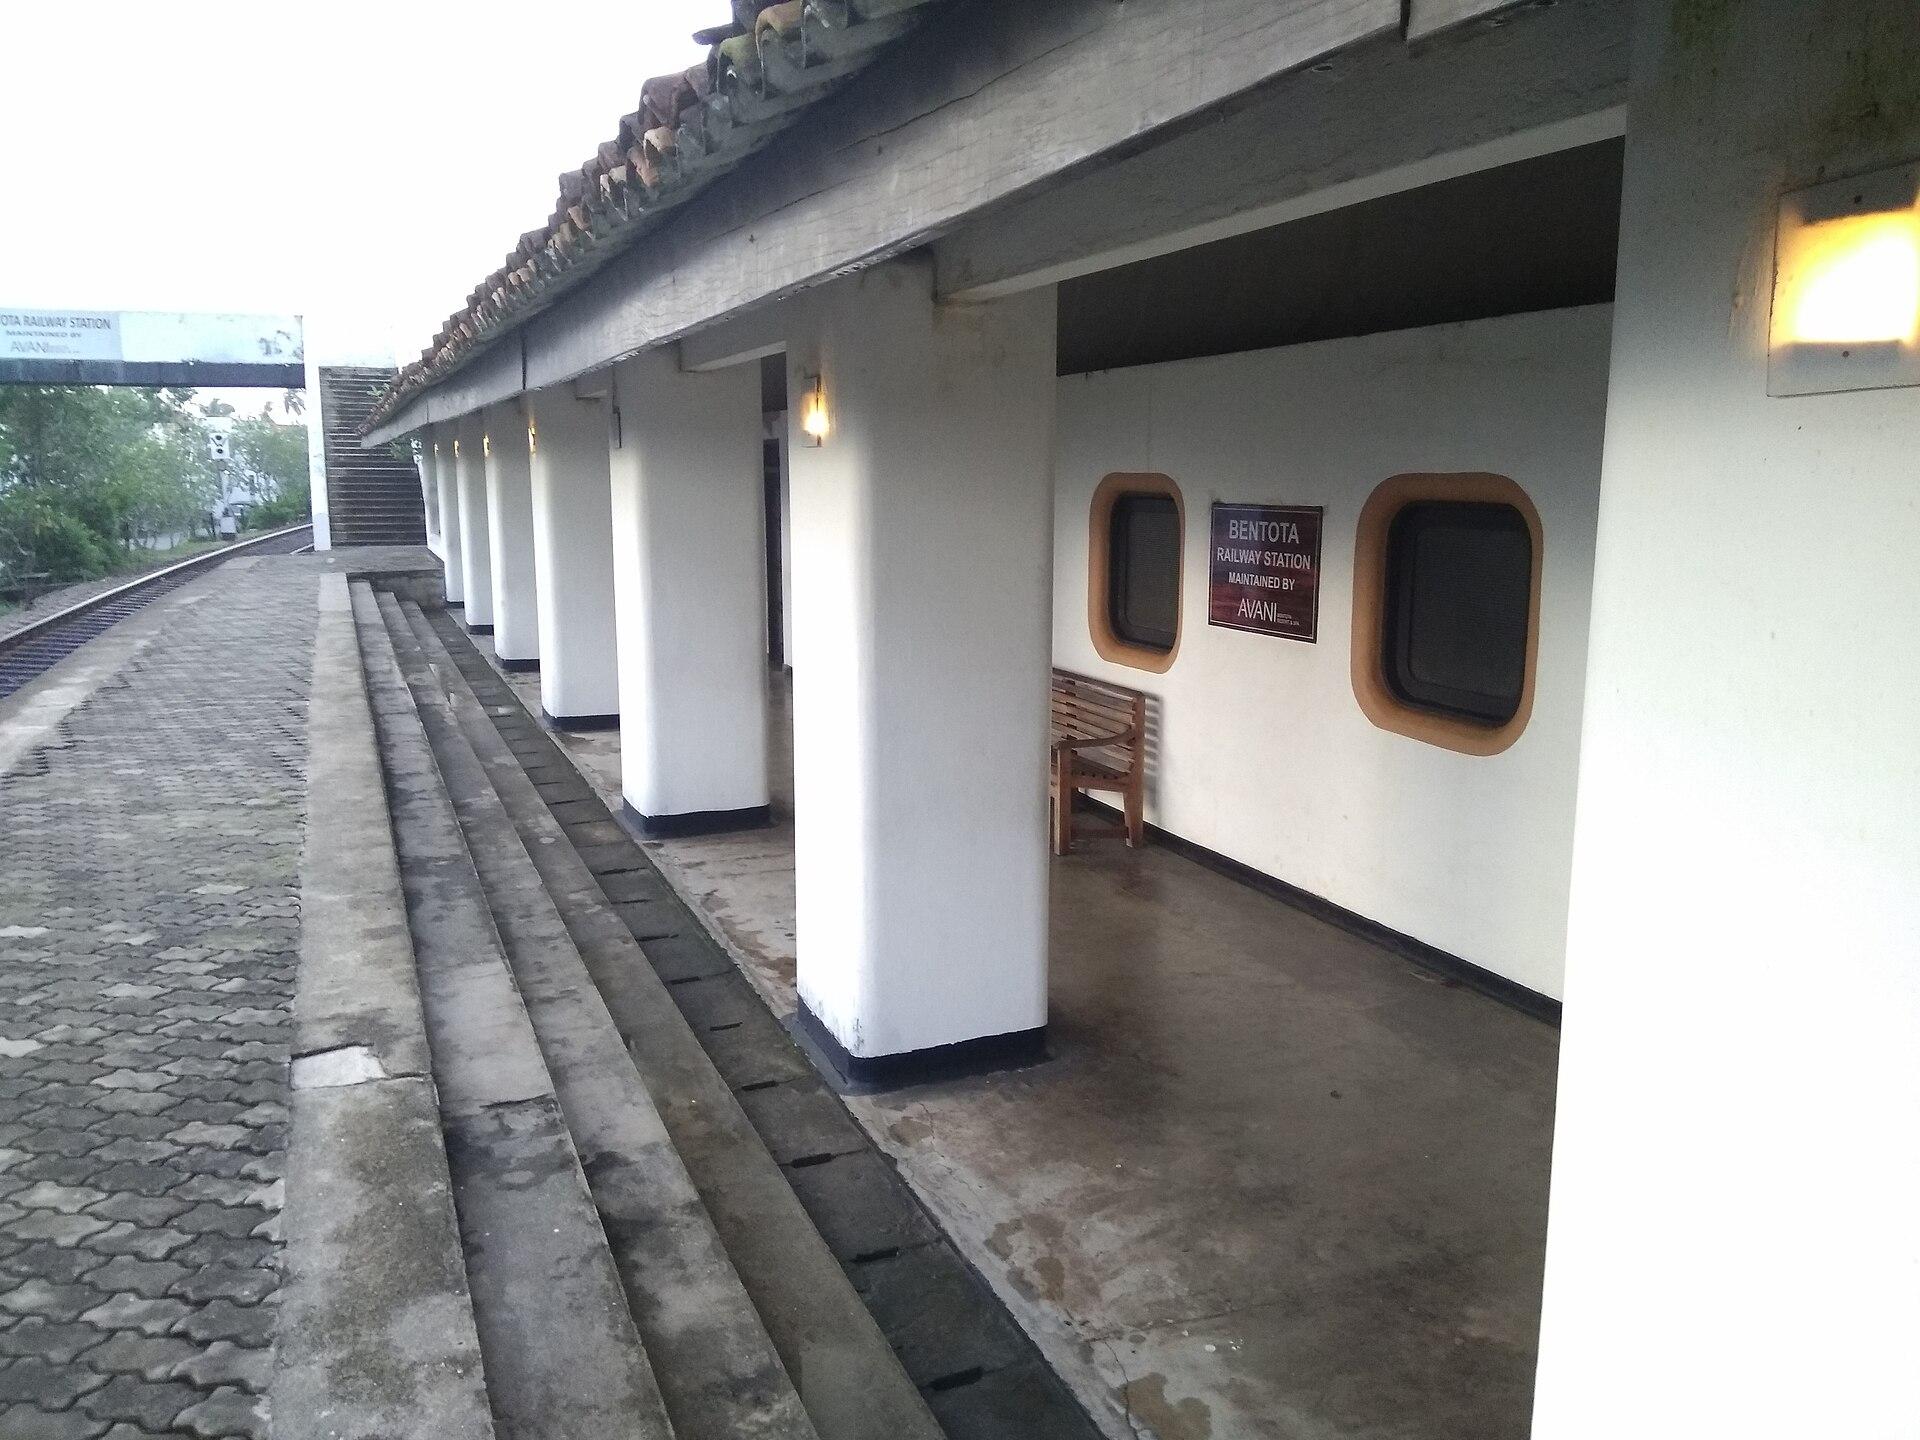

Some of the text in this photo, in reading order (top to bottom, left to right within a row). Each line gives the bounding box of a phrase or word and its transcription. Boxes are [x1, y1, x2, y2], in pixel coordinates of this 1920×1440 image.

[23, 315, 66, 328] RAILWAY
[70, 317, 111, 329] STATION
[1229, 519, 1299, 544] BENTOTA
[1217, 547, 1310, 570] RAILWAY STATION
[1228, 572, 1295, 591] MAINTAINED BY
[1238, 598, 1277, 622] AVANI
